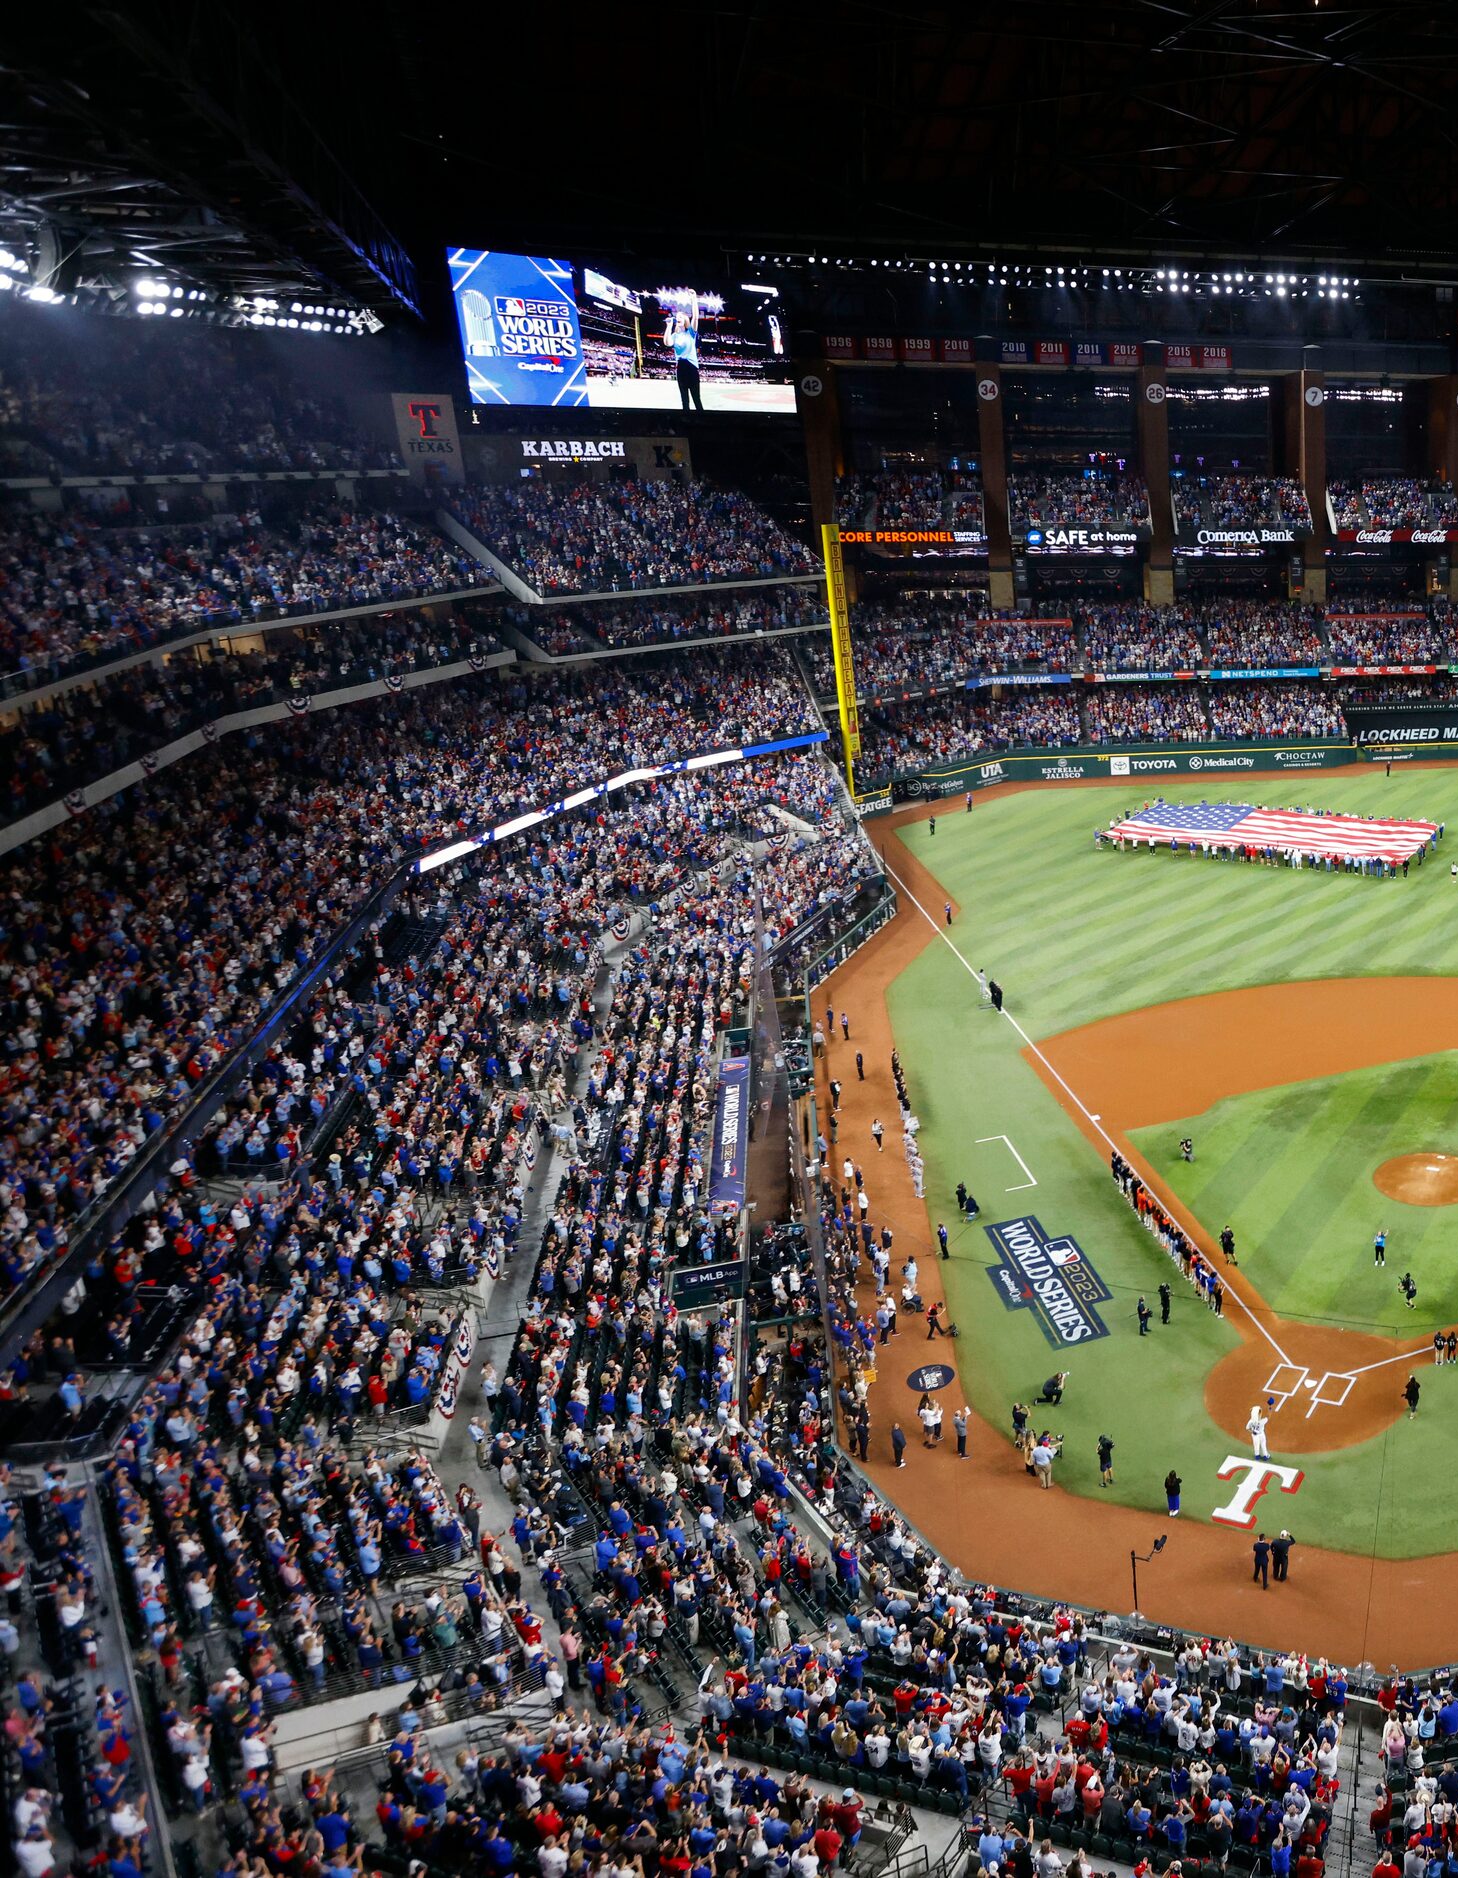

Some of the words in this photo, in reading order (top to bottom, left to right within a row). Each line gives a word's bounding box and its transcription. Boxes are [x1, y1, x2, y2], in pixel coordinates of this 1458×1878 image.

[526, 304, 569, 316] 2023
[497, 316, 573, 337] WORLD
[501, 334, 577, 357] SERIES
[826, 337, 852, 348] 1996
[866, 338, 893, 348] 1998
[904, 339, 931, 349] 1999
[944, 340, 969, 350] 2010
[1002, 342, 1025, 352] 2010
[1041, 343, 1063, 353] 2011
[1078, 344, 1098, 354] 2011
[1114, 345, 1136, 355] 2012
[1168, 346, 1190, 357] 2015
[1204, 347, 1226, 358] 2016
[804, 381, 819, 393] 42
[980, 384, 996, 395] 34
[1148, 388, 1163, 399] 26
[1311, 392, 1318, 401] 7
[408, 440, 453, 454] TEXAS
[521, 441, 625, 456] KARBACH
[653, 445, 674, 467] K
[838, 532, 872, 542] CORE
[876, 531, 954, 542] PERSONNEL
[1045, 530, 1088, 545] SAFE
[1091, 533, 1104, 541] at
[1106, 532, 1137, 541] home
[1261, 530, 1294, 541] Bank
[831, 543, 847, 611] BRING
[838, 613, 850, 653] THE
[842, 656, 854, 707] HEAT
[1360, 728, 1440, 741] LOCKHEED
[1280, 752, 1325, 760] CHOCTAW
[1132, 760, 1177, 769] TOYOTA
[1204, 758, 1236, 767] Medical
[1237, 757, 1254, 767] City
[981, 763, 1003, 778] UTA
[907, 783, 919, 791] BG
[724, 1094, 739, 1119] WORLD
[722, 1119, 738, 1145] SERIES
[700, 1271, 724, 1282] MLB
[1001, 1221, 1053, 1280] WORLD
[1033, 1278, 1092, 1342] SERIES
[1064, 1264, 1098, 1302] 2023
[1211, 1455, 1305, 1529] T
